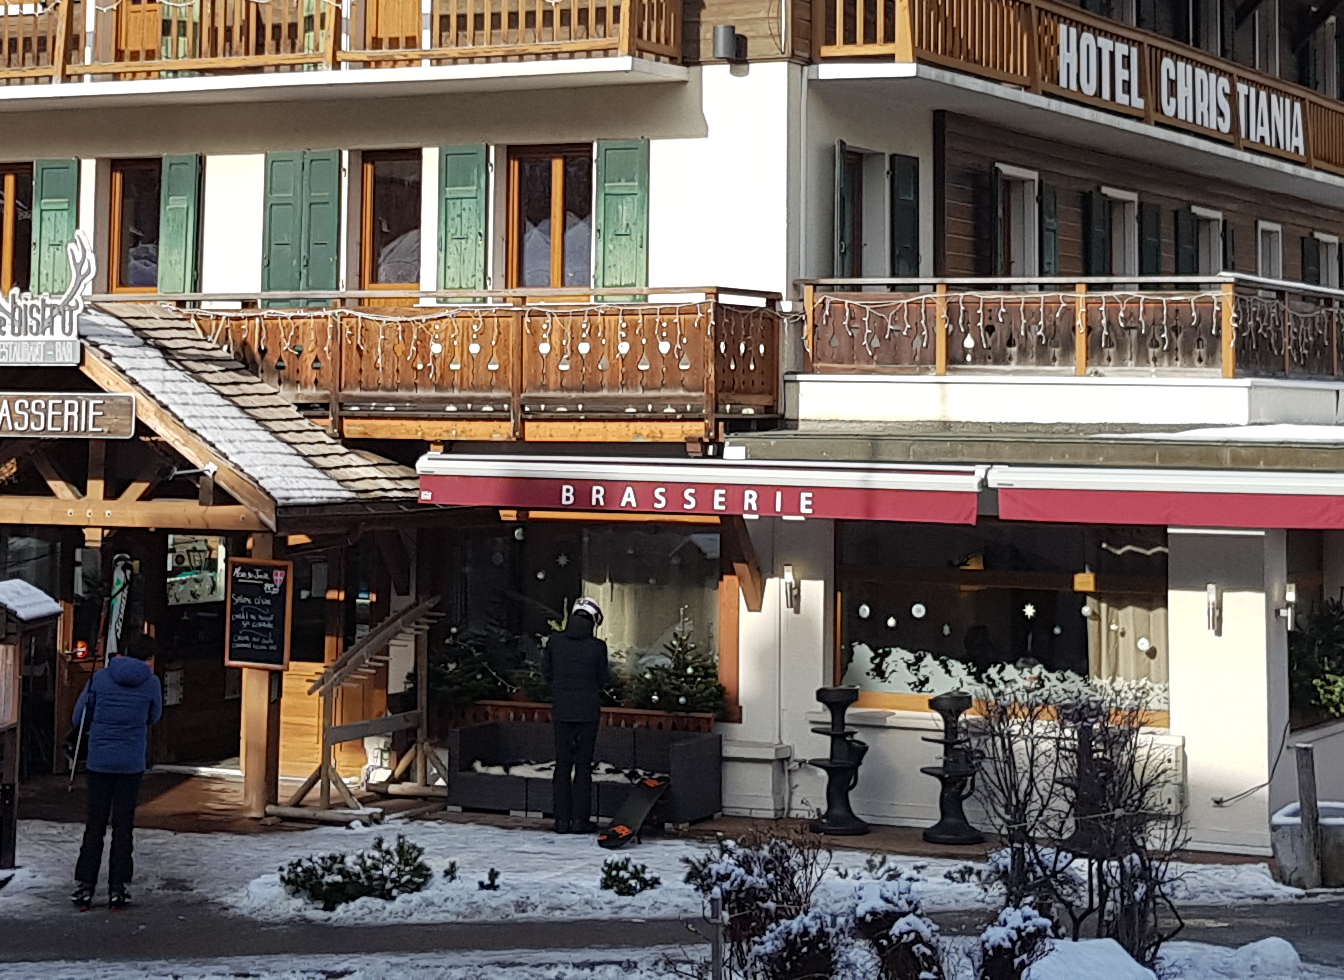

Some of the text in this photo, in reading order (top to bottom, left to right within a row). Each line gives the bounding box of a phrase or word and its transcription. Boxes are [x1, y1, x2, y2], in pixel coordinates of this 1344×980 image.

[1059, 23, 1144, 109] HOTEL
[10, 293, 73, 337] bistro
[55, 341, 73, 362] BAR
[561, 485, 813, 514] BRASSERIE
